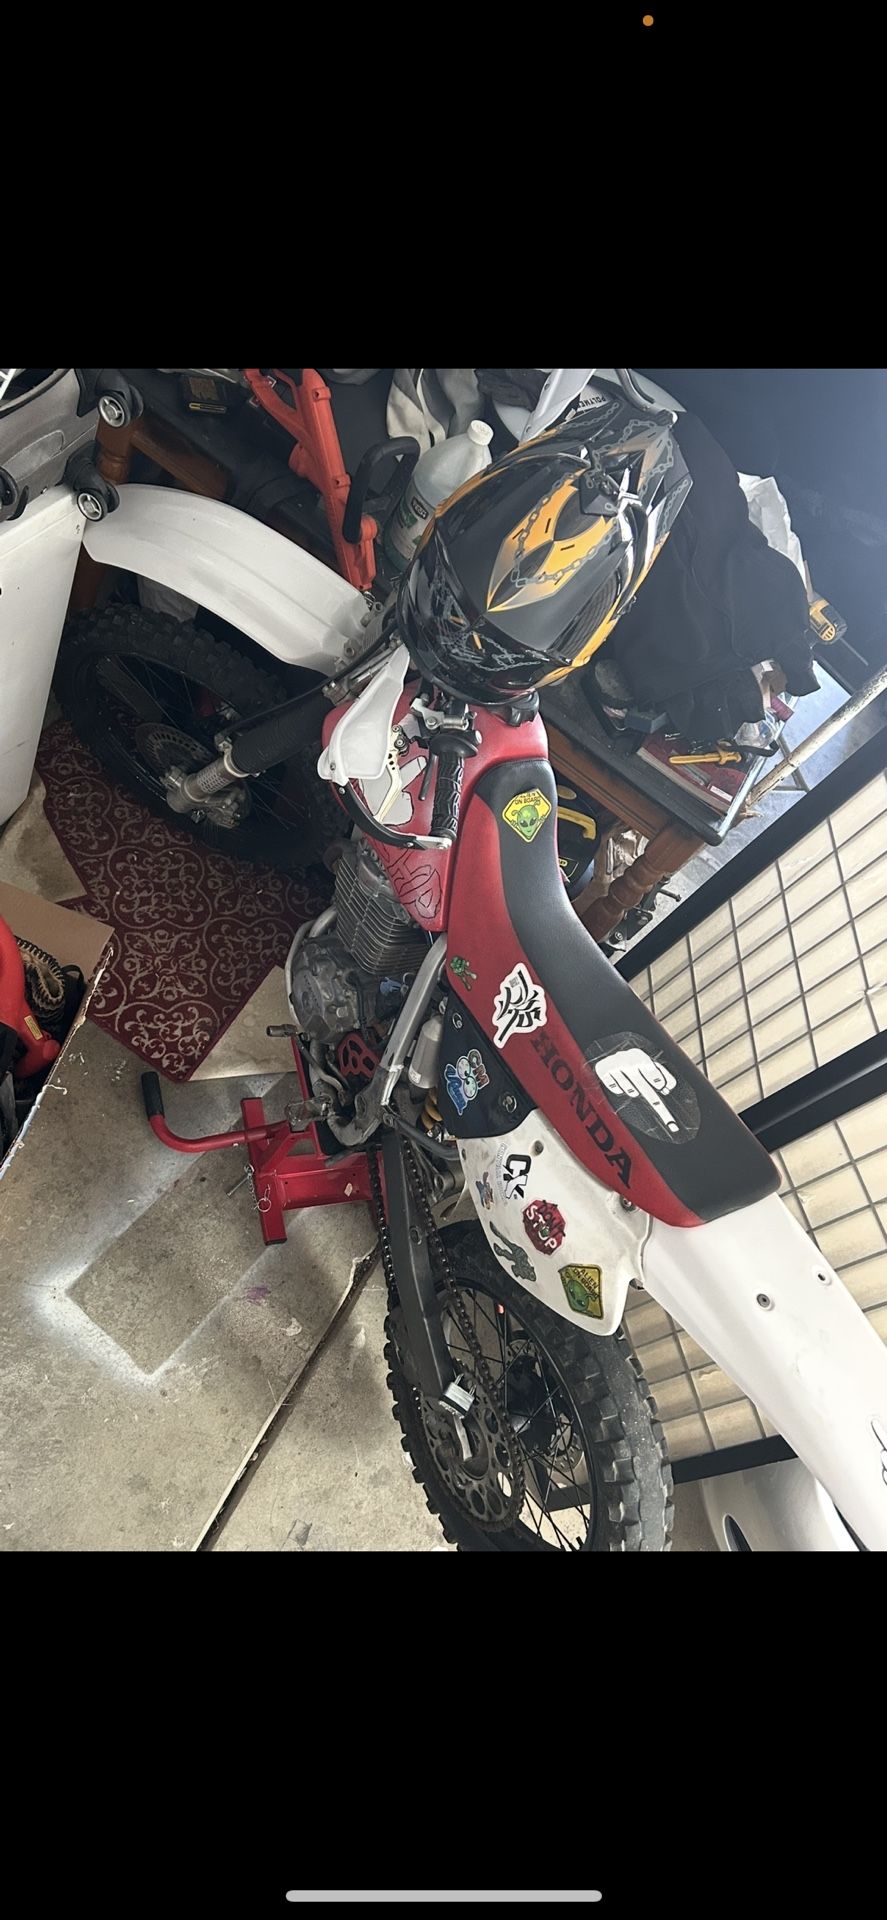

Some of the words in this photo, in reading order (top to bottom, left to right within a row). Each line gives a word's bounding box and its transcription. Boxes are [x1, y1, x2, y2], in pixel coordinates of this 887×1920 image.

[530, 1030, 632, 1189] HONDA
[526, 1205, 557, 1248] STOP
[580, 1269, 599, 1289] ALIEN
